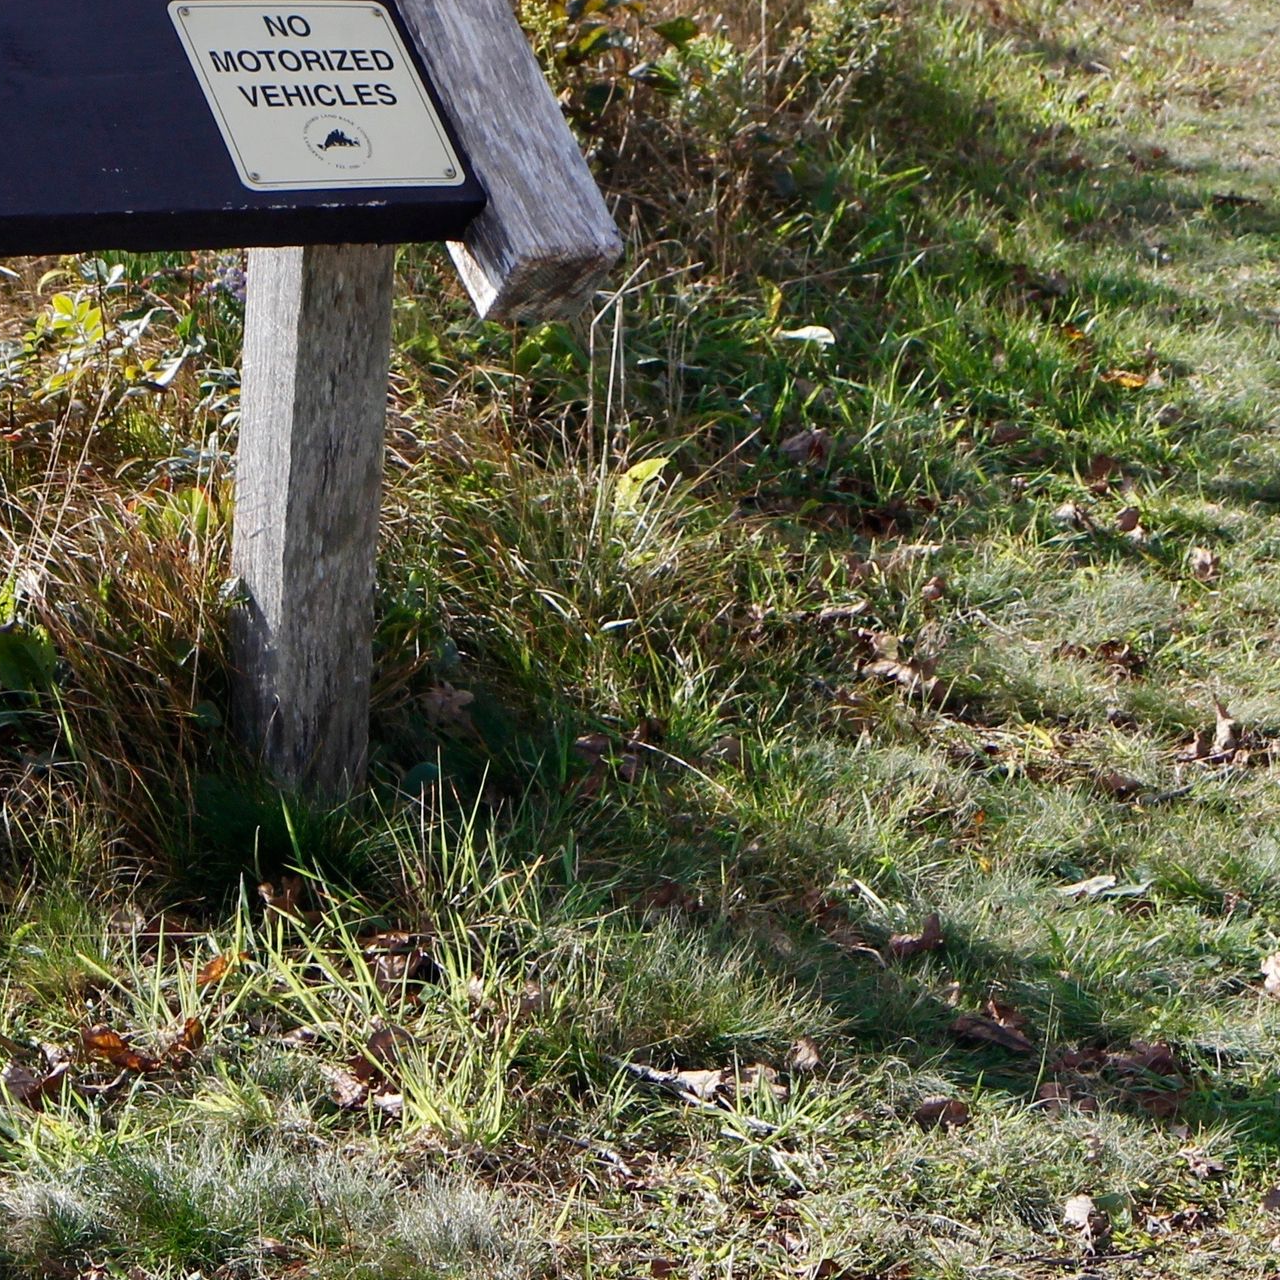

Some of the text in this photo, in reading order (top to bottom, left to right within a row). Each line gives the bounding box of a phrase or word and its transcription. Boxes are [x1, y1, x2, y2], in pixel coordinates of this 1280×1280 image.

[263, 15, 312, 37] NO
[209, 50, 395, 73] MOTORIZED
[237, 84, 397, 107] VEHICLES
